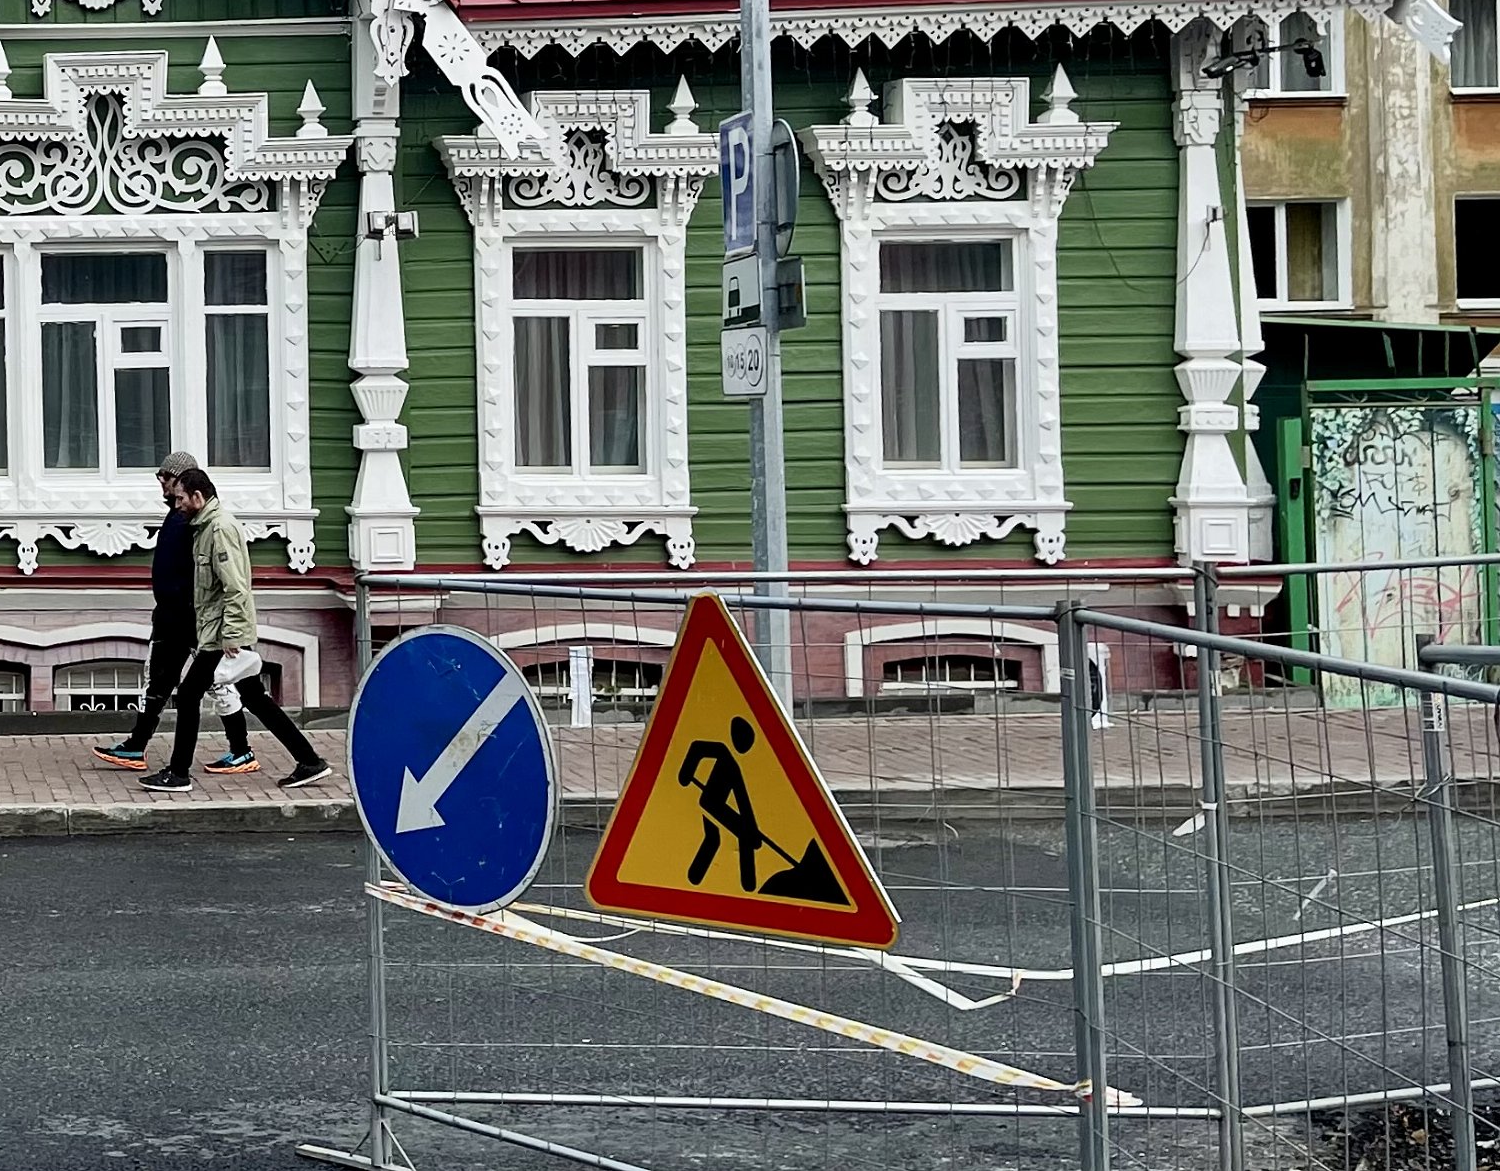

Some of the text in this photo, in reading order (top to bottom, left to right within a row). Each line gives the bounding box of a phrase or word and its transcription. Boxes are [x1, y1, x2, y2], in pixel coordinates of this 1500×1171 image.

[728, 127, 750, 241] P
[735, 352, 745, 370] 15
[747, 349, 760, 371] 20
